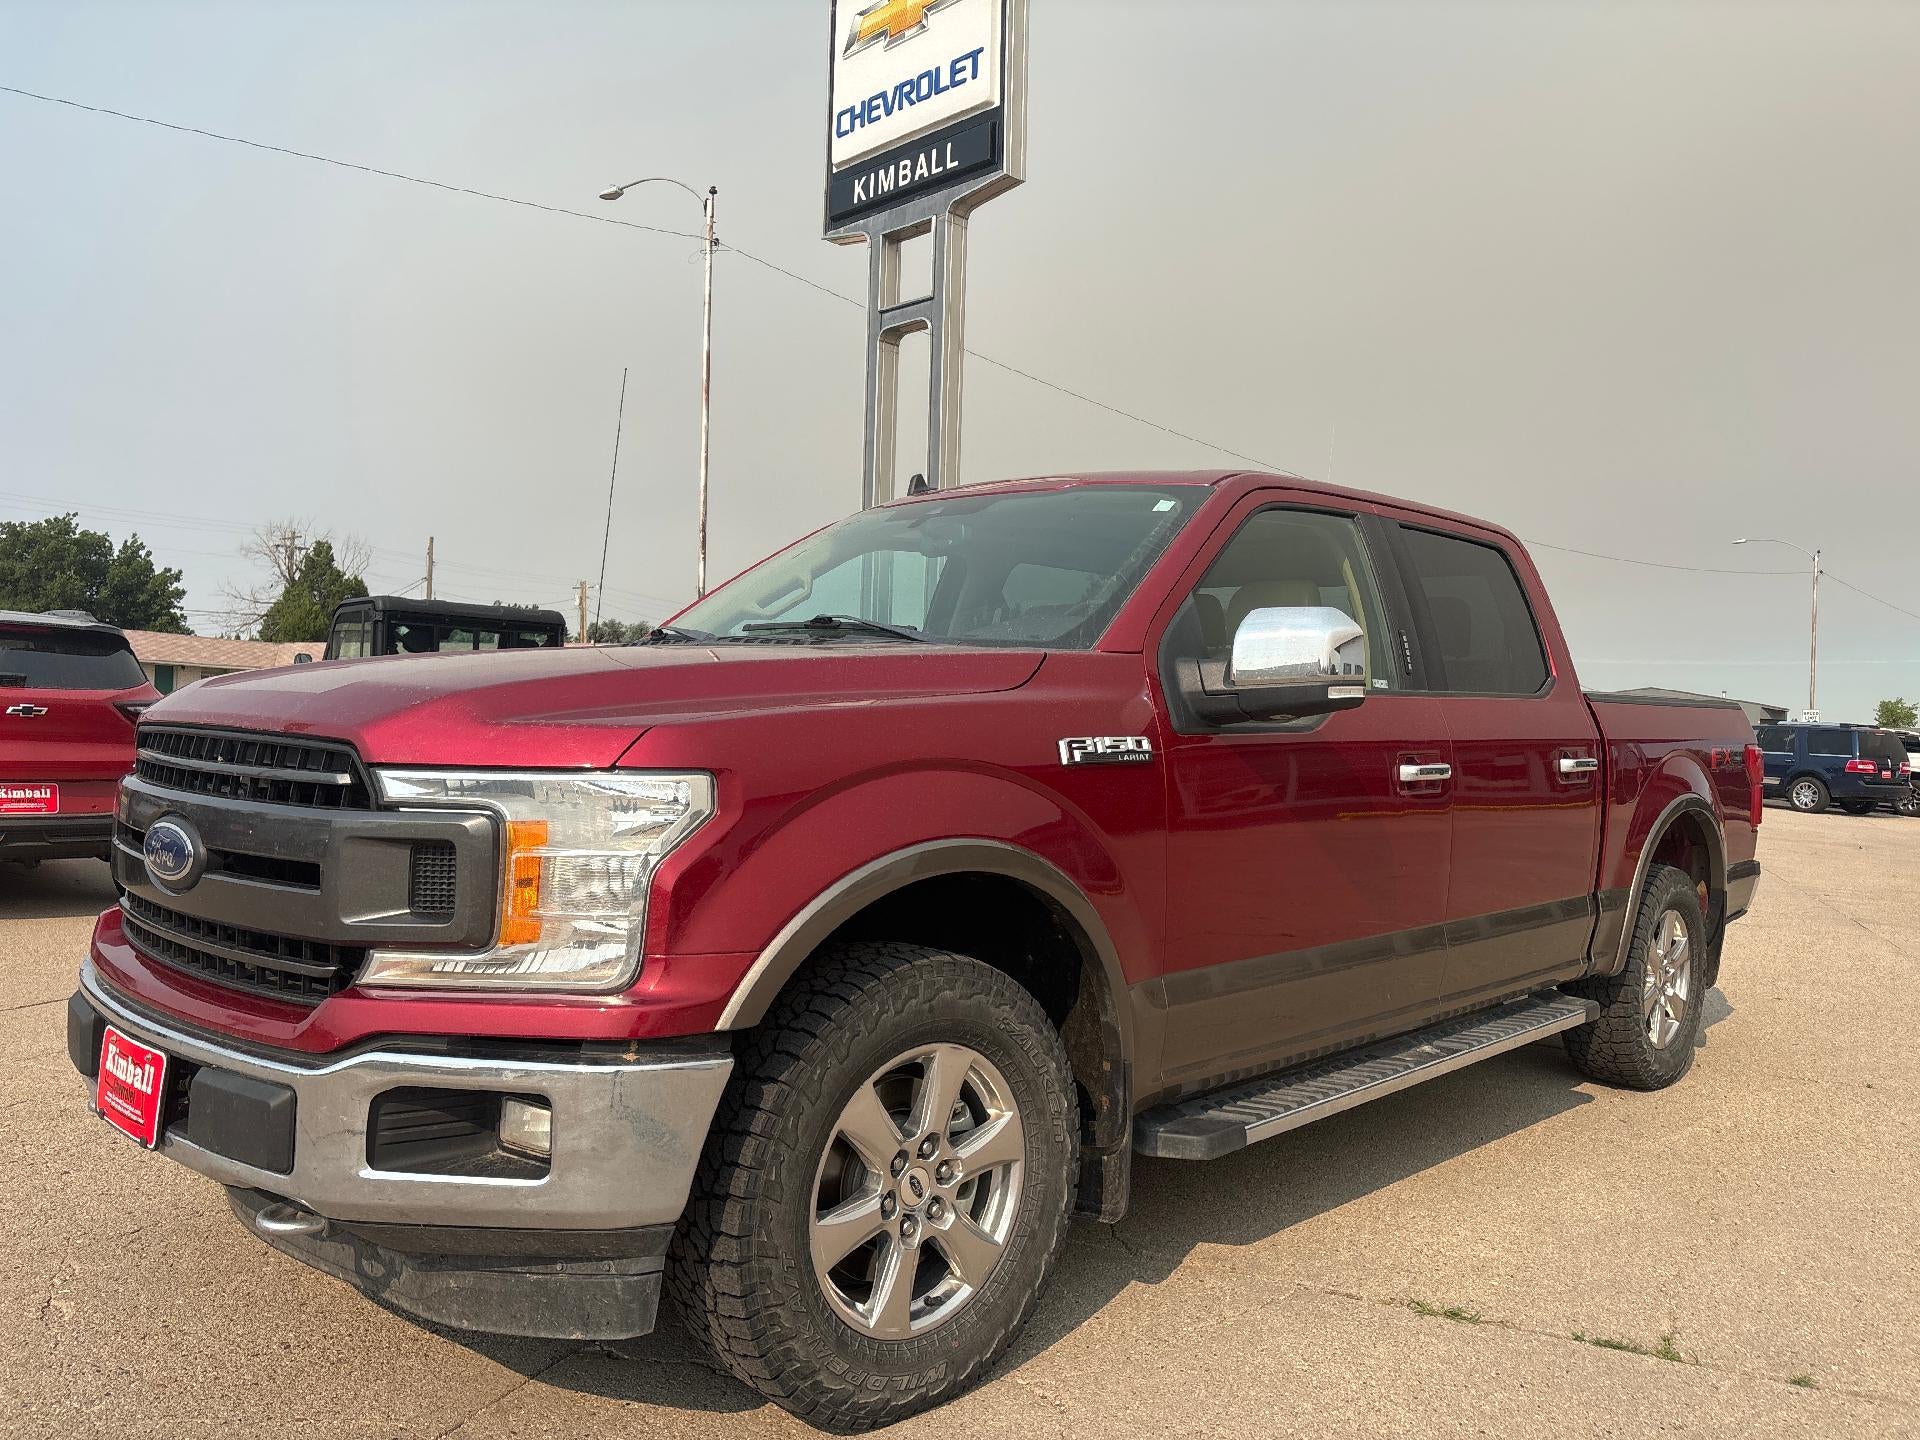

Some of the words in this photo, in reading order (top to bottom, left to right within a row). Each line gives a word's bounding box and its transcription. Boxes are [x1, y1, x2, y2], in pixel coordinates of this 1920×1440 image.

[835, 46, 985, 139] CHEVROLET
[853, 142, 959, 204] KIMBALL
[1118, 753, 1150, 761] LARIAT
[0, 788, 51, 799] Kimball
[147, 832, 178, 868] Ford
[105, 1042, 155, 1096] Kimball
[799, 1318, 948, 1392] WILDPEAK
